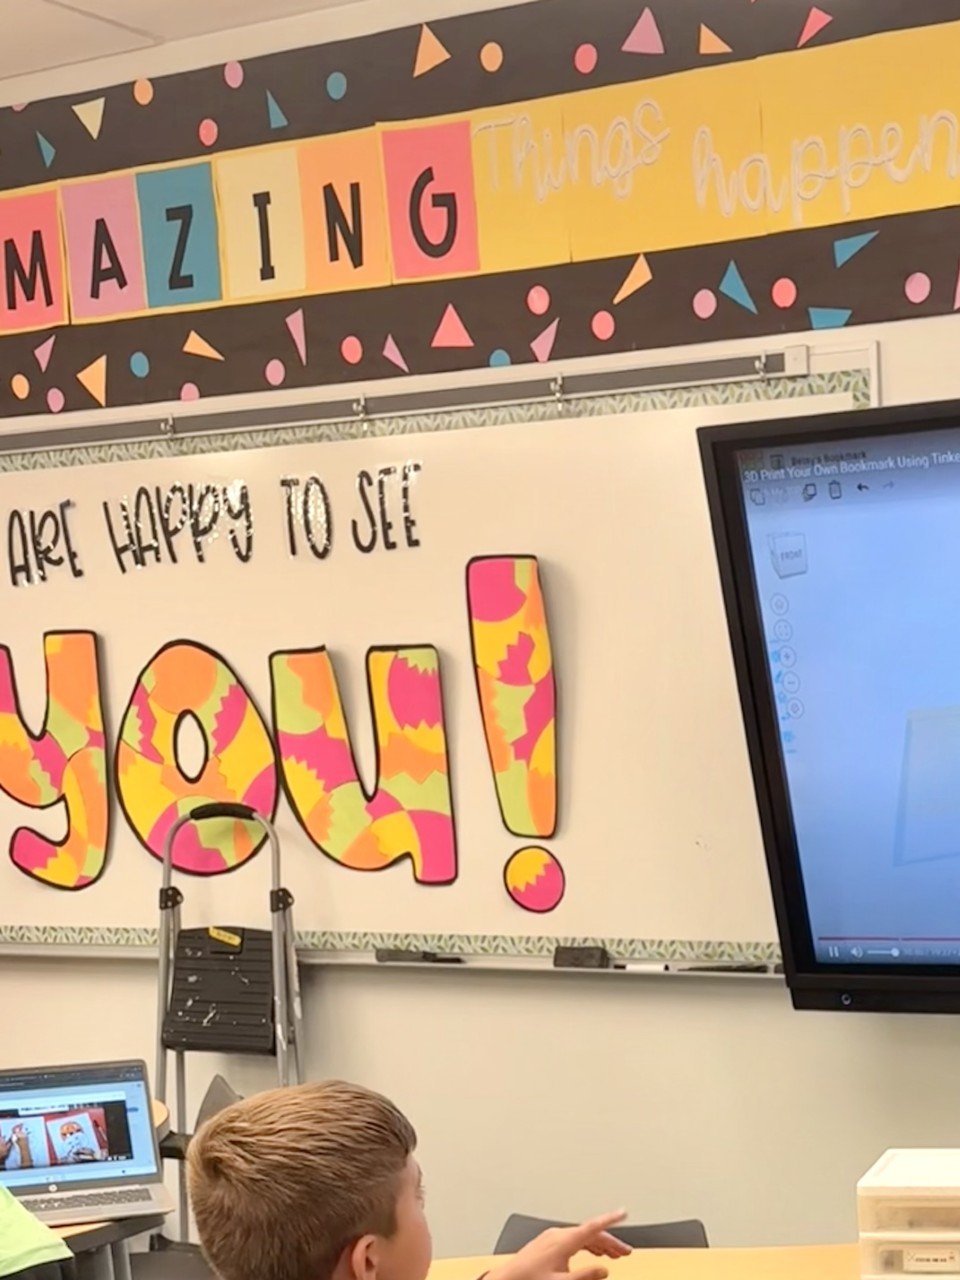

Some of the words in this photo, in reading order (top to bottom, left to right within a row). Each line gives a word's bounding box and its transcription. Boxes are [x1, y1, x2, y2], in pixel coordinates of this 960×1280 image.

[472, 98, 670, 203] Things
[743, 470, 759, 482] 3D
[760, 467, 786, 480] Print
[787, 466, 812, 479] Your
[813, 463, 839, 476] Own
[840, 456, 896, 473] Bookmark
[897, 456, 930, 469] Using
[8, 499, 85, 587] ARE
[103, 478, 255, 574] HAPPY
[280, 473, 334, 560] TO
[351, 461, 423, 553] SEE
